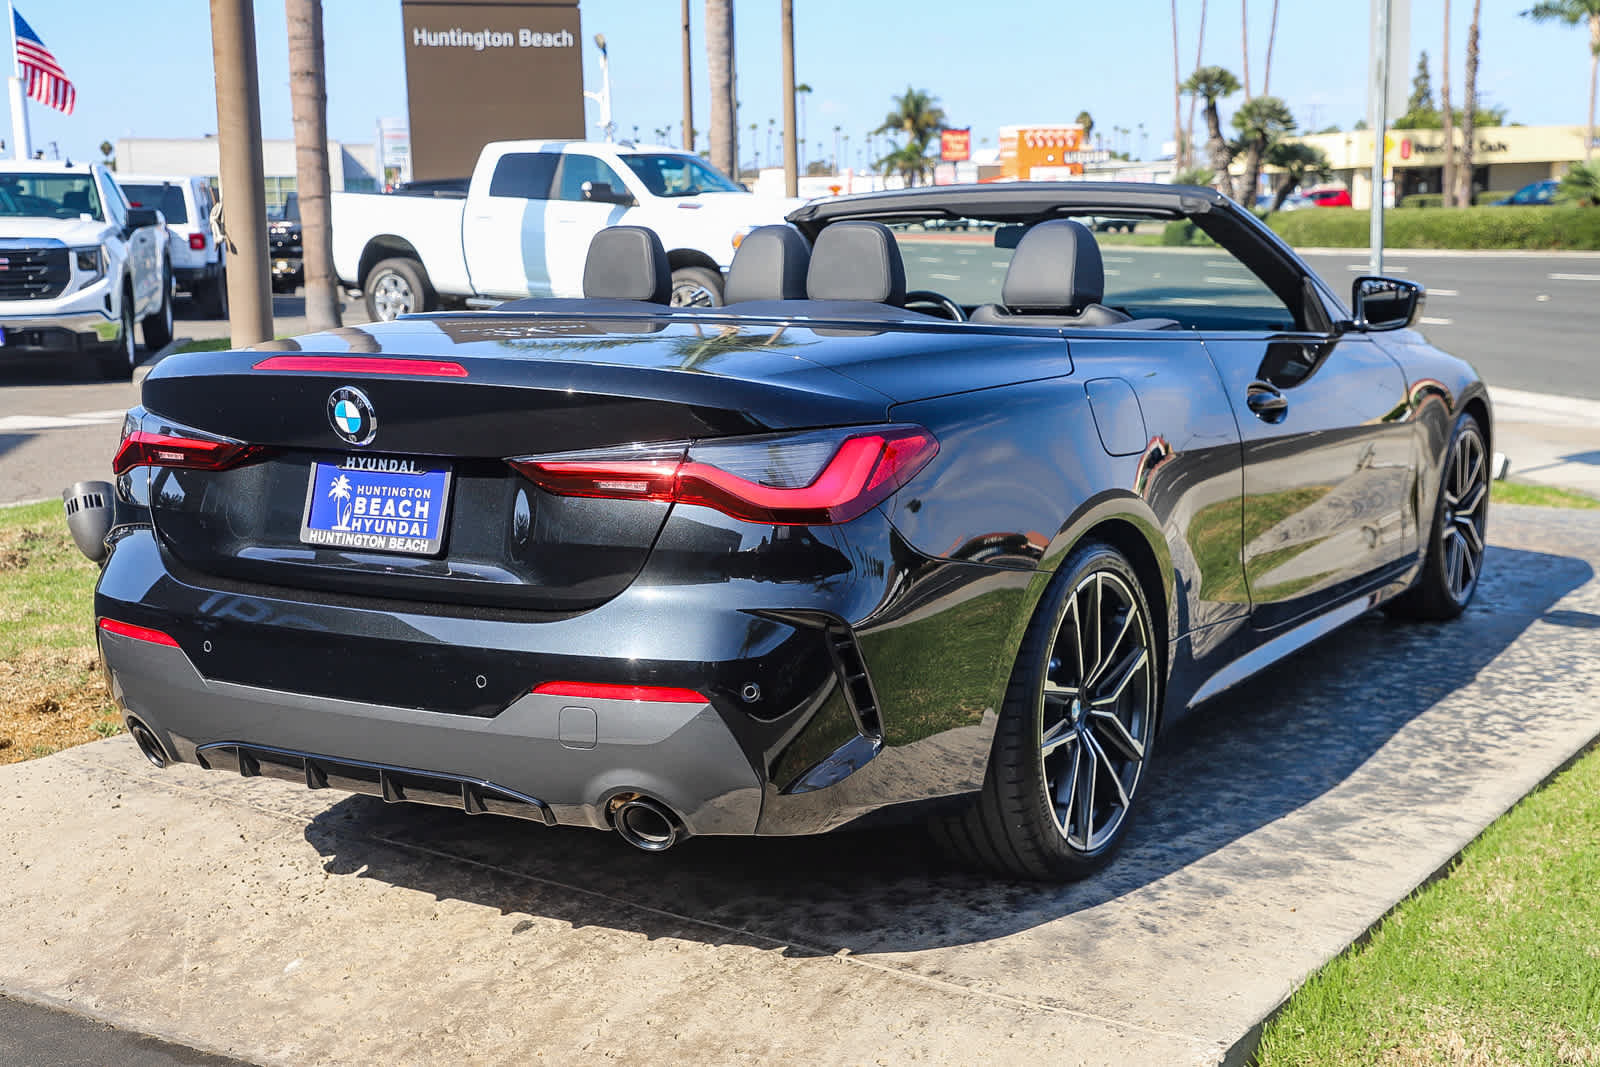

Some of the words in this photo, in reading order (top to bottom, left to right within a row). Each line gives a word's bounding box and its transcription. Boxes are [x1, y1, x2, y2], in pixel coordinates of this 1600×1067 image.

[413, 28, 514, 51] Huntington
[518, 28, 574, 48] Beach
[346, 457, 416, 473] HYUNDAI
[357, 485, 432, 499] HUNTINGTON
[353, 498, 430, 519] BEACH
[351, 518, 428, 537] HYUNDAI
[309, 530, 388, 549] HUNTINGTON
[389, 537, 429, 552] BEACH
